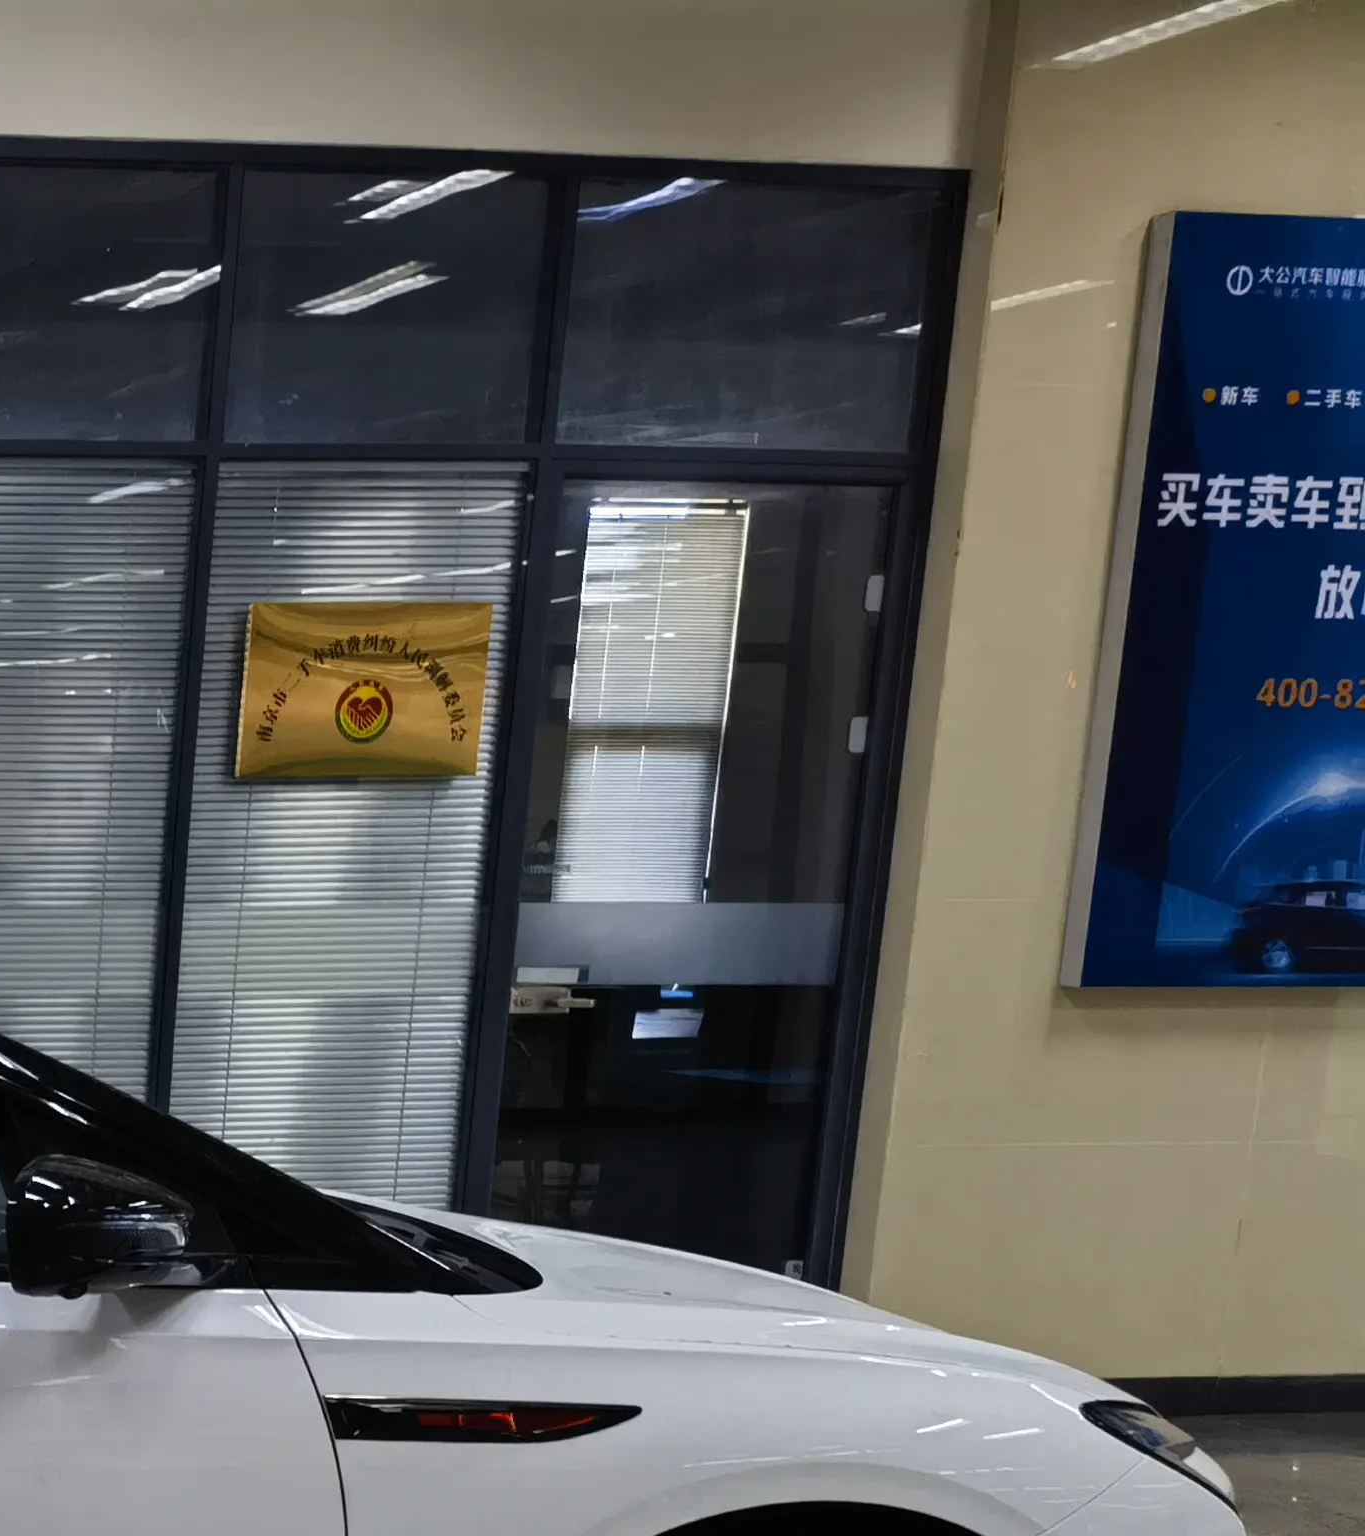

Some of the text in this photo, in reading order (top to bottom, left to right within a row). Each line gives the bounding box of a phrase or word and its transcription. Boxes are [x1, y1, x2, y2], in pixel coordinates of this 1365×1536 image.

[1220, 385, 1260, 406] 新车
[1304, 389, 1362, 409] 二手车
[1314, 564, 1365, 620] 放
